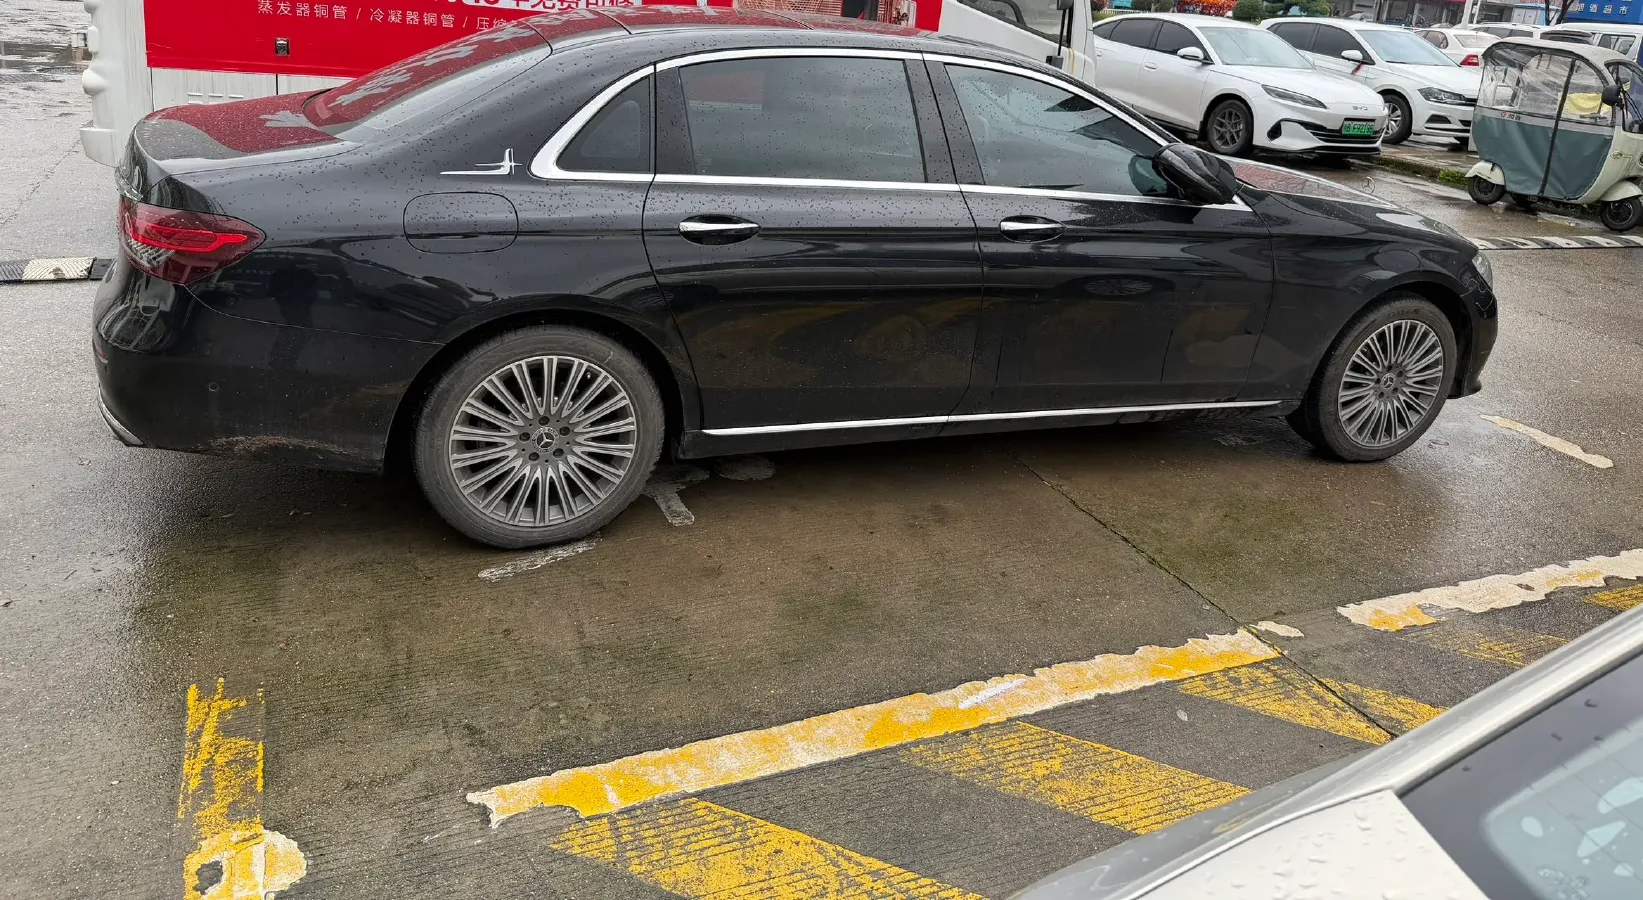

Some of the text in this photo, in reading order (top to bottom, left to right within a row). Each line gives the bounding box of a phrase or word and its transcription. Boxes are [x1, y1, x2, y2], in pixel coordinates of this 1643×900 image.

[257, 0, 348, 20] 蒸发器铜管
[369, 8, 455, 28] 冷凝器铜管
[476, 16, 517, 30] 压缩
